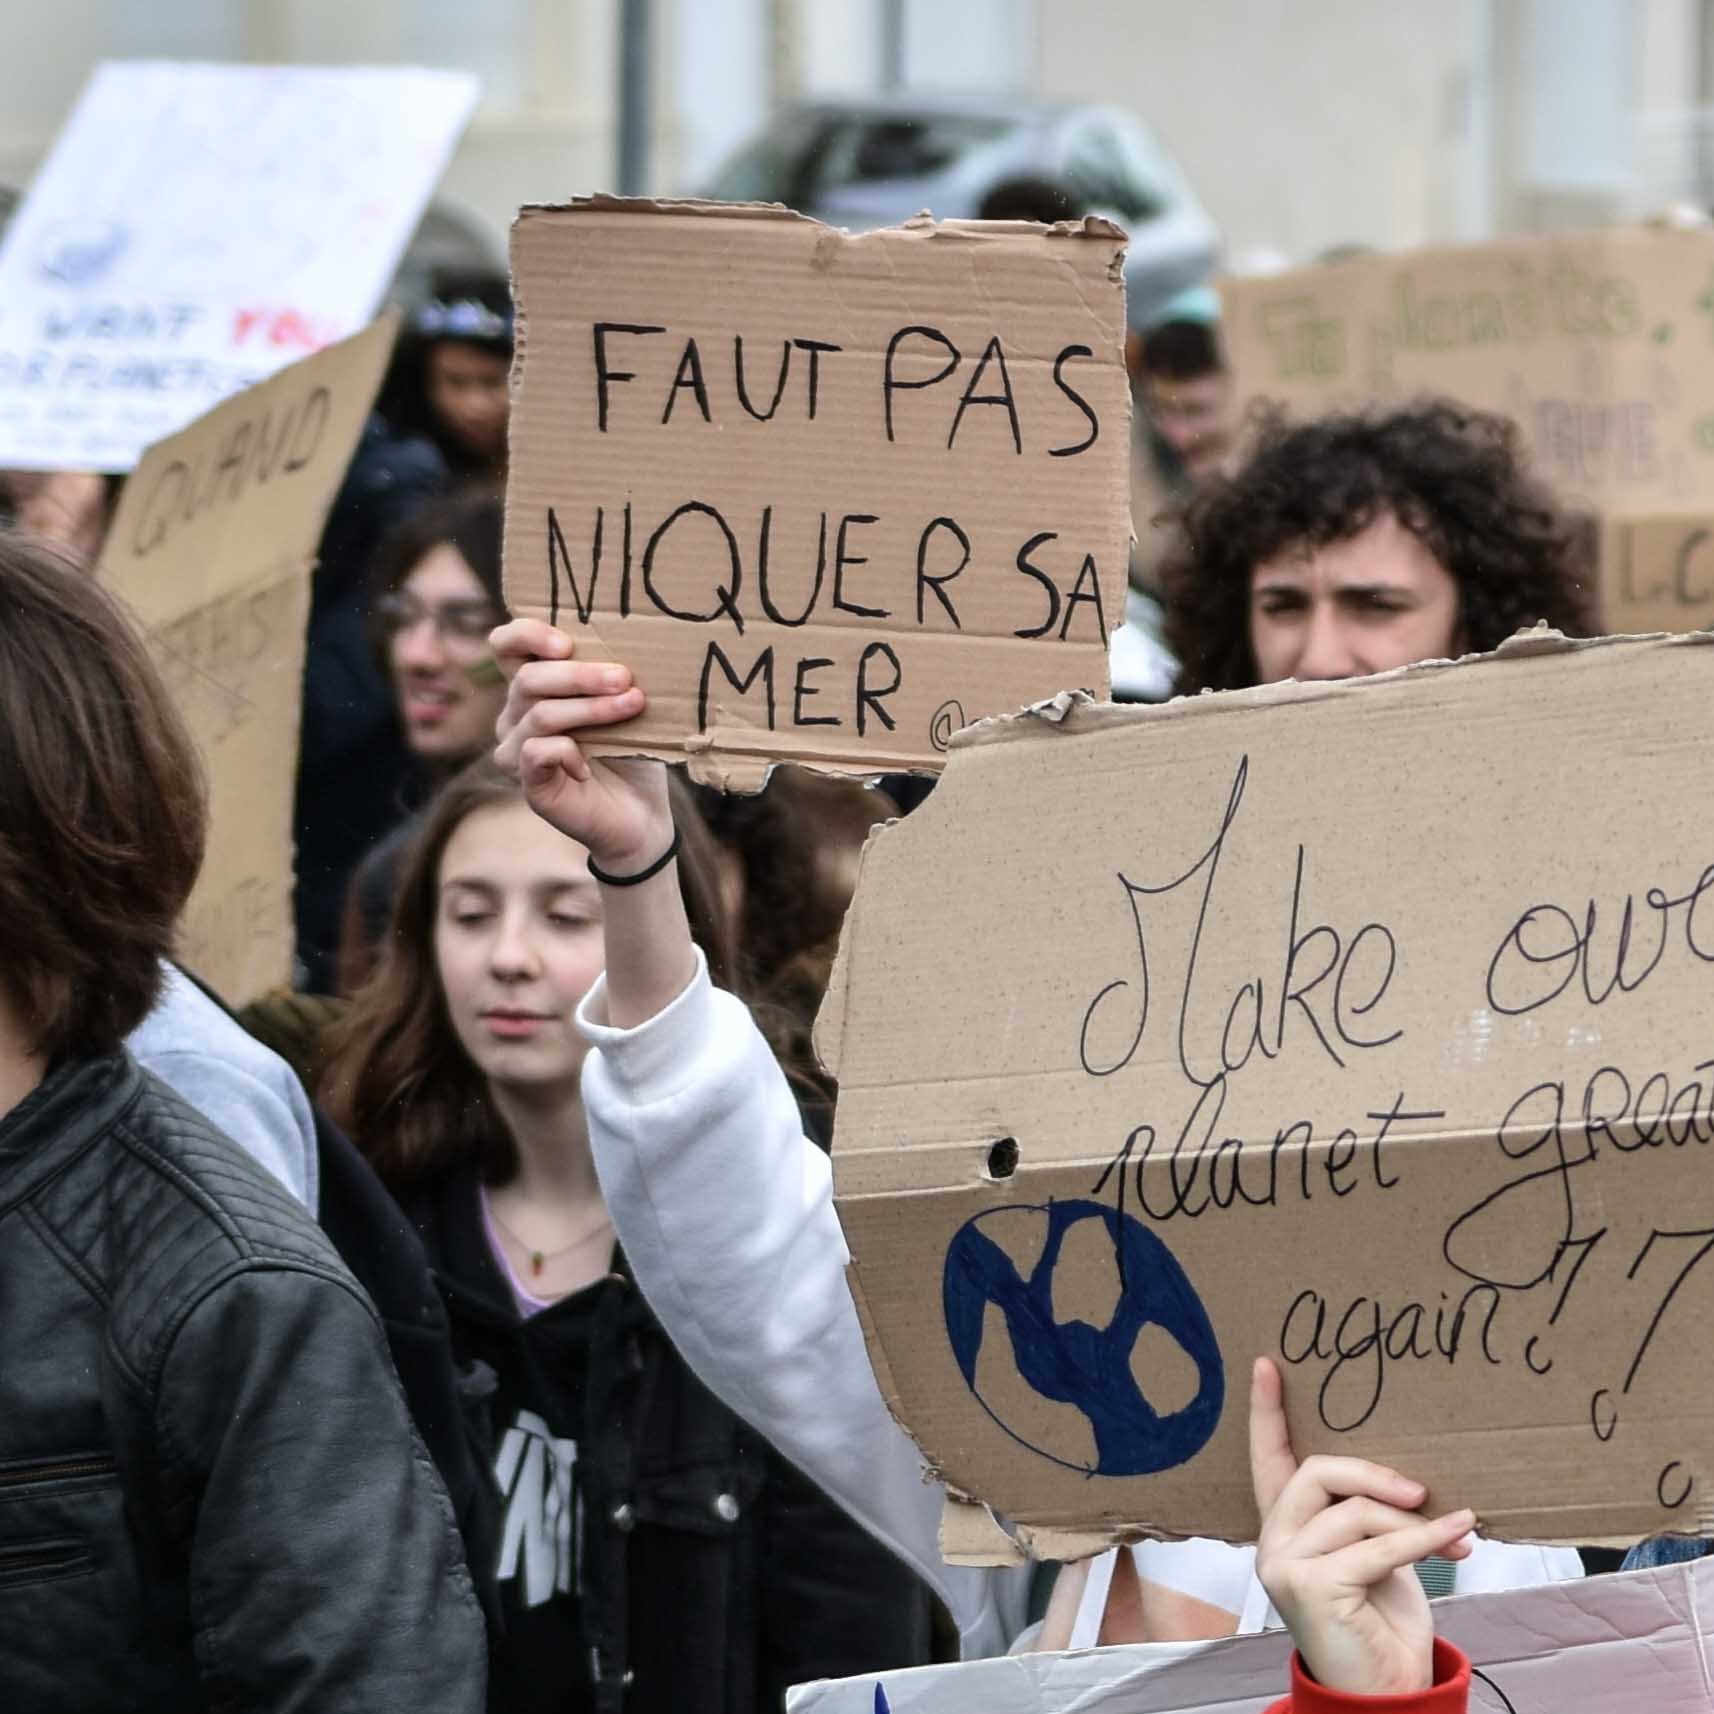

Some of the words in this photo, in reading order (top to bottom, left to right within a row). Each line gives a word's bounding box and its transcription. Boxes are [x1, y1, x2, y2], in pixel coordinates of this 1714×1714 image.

[593, 321, 843, 433] FAUT
[883, 325, 1100, 457] PAS
[547, 499, 972, 636] NIQUER
[1012, 530, 1108, 651] SA
[697, 640, 902, 738] MER
[1077, 752, 1405, 1087] Make
[1091, 1071, 1446, 1293] planet
